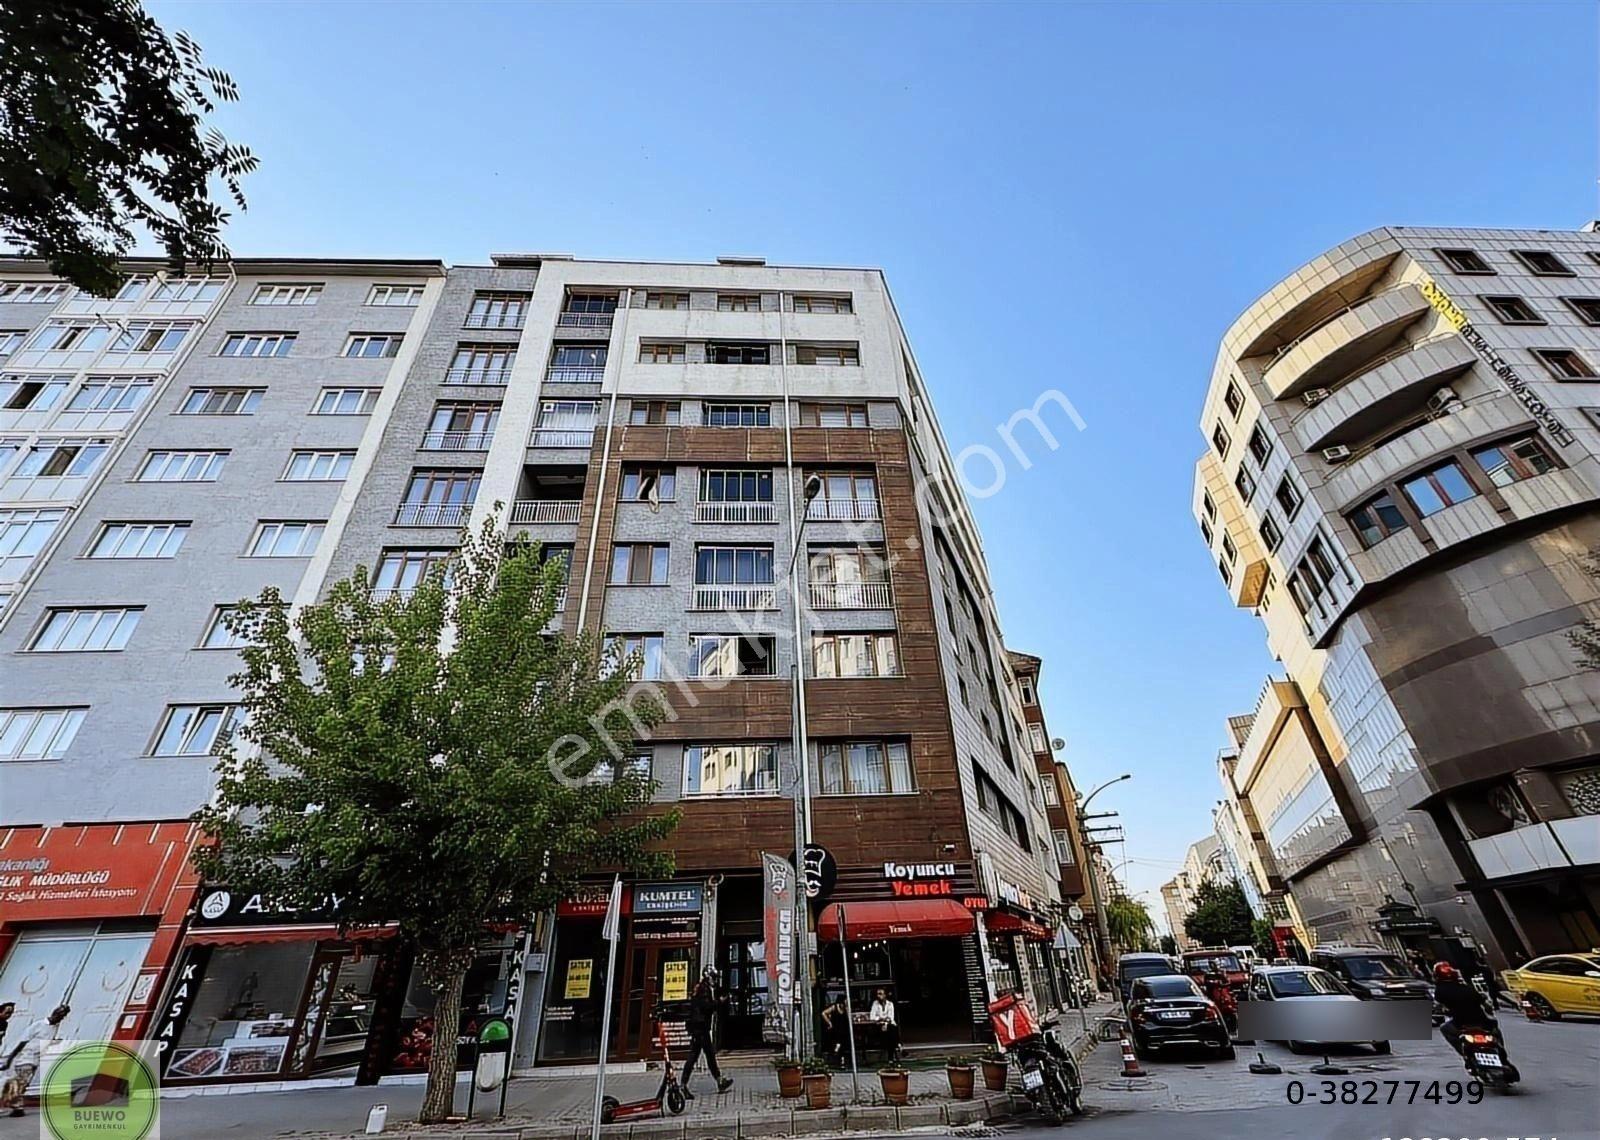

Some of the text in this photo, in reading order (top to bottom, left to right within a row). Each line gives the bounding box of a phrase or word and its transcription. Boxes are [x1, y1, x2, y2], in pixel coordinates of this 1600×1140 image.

[29, 870, 110, 886] MÜDÜRLÜĞÜ
[884, 862, 955, 880] Koyuncu
[640, 890, 696, 901] KUMTEL
[892, 879, 951, 895] Yemek
[503, 950, 525, 1020] KASA
[153, 964, 198, 1058] KASAP
